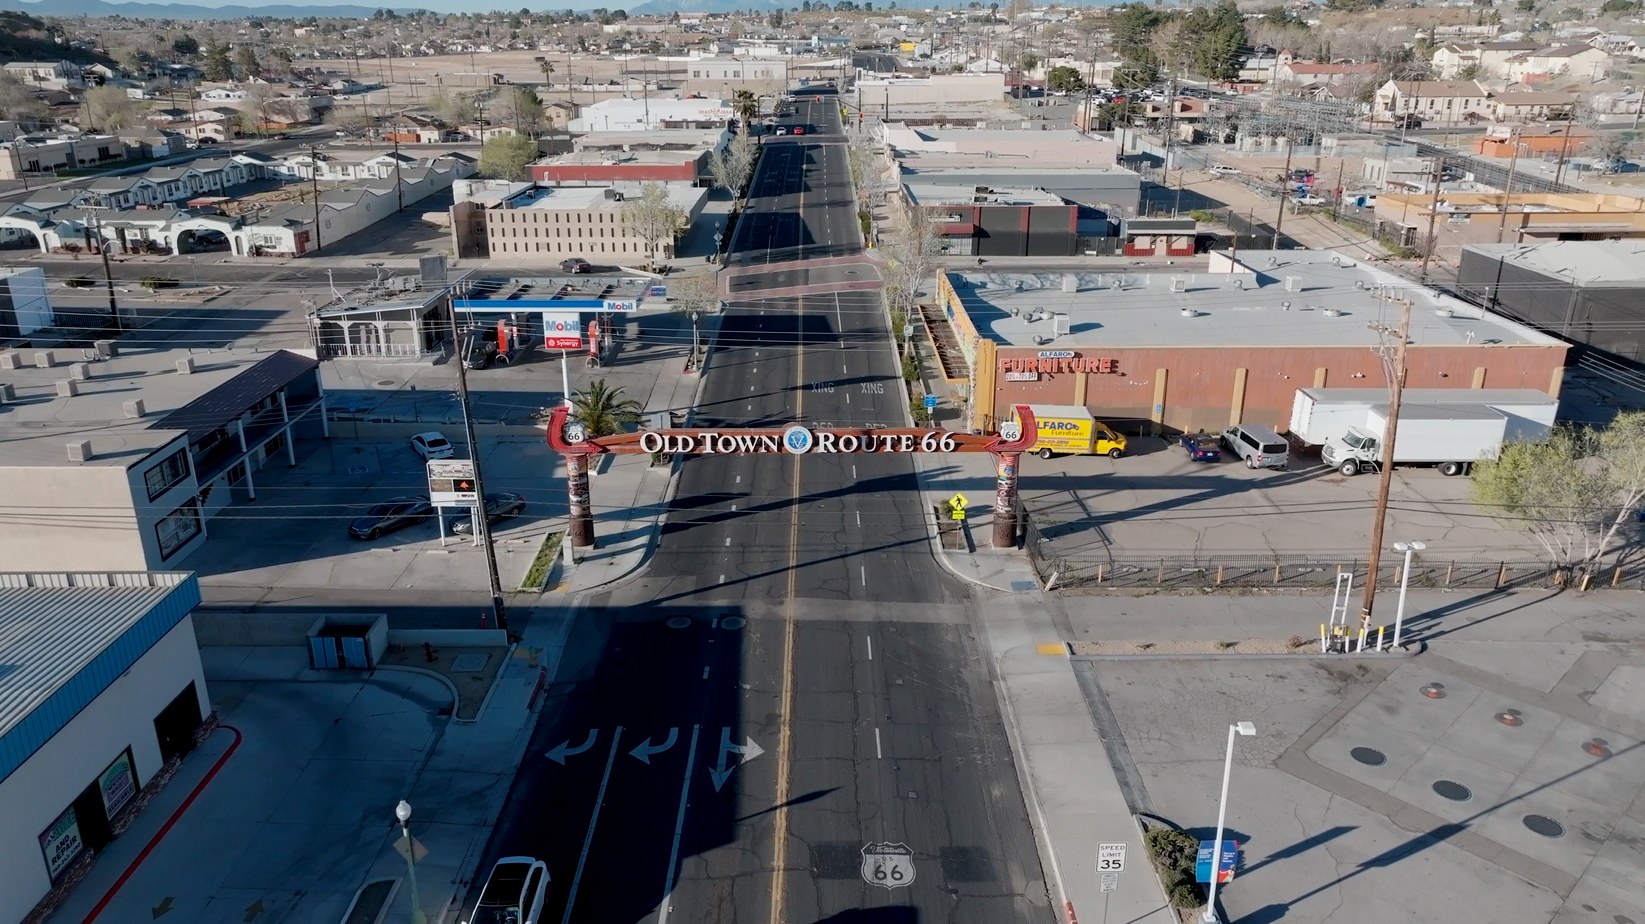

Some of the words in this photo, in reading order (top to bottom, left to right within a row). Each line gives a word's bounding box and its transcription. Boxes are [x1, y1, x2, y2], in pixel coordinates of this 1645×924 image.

[546, 320, 580, 331] Mobil
[999, 358, 1111, 373] FURNITURE
[811, 382, 835, 393] XING
[861, 383, 885, 394] XING
[1037, 421, 1072, 430] LFARO
[568, 433, 580, 441] 66
[1005, 431, 1017, 439] 66
[639, 432, 692, 454] OLD
[696, 432, 779, 454] TOWN
[818, 432, 914, 453] ROUTE
[921, 431, 955, 453] 66
[55, 834, 70, 853] AND
[51, 835, 78, 866] REPAIR
[1101, 859, 1121, 869] 35
[875, 864, 903, 881] 66
